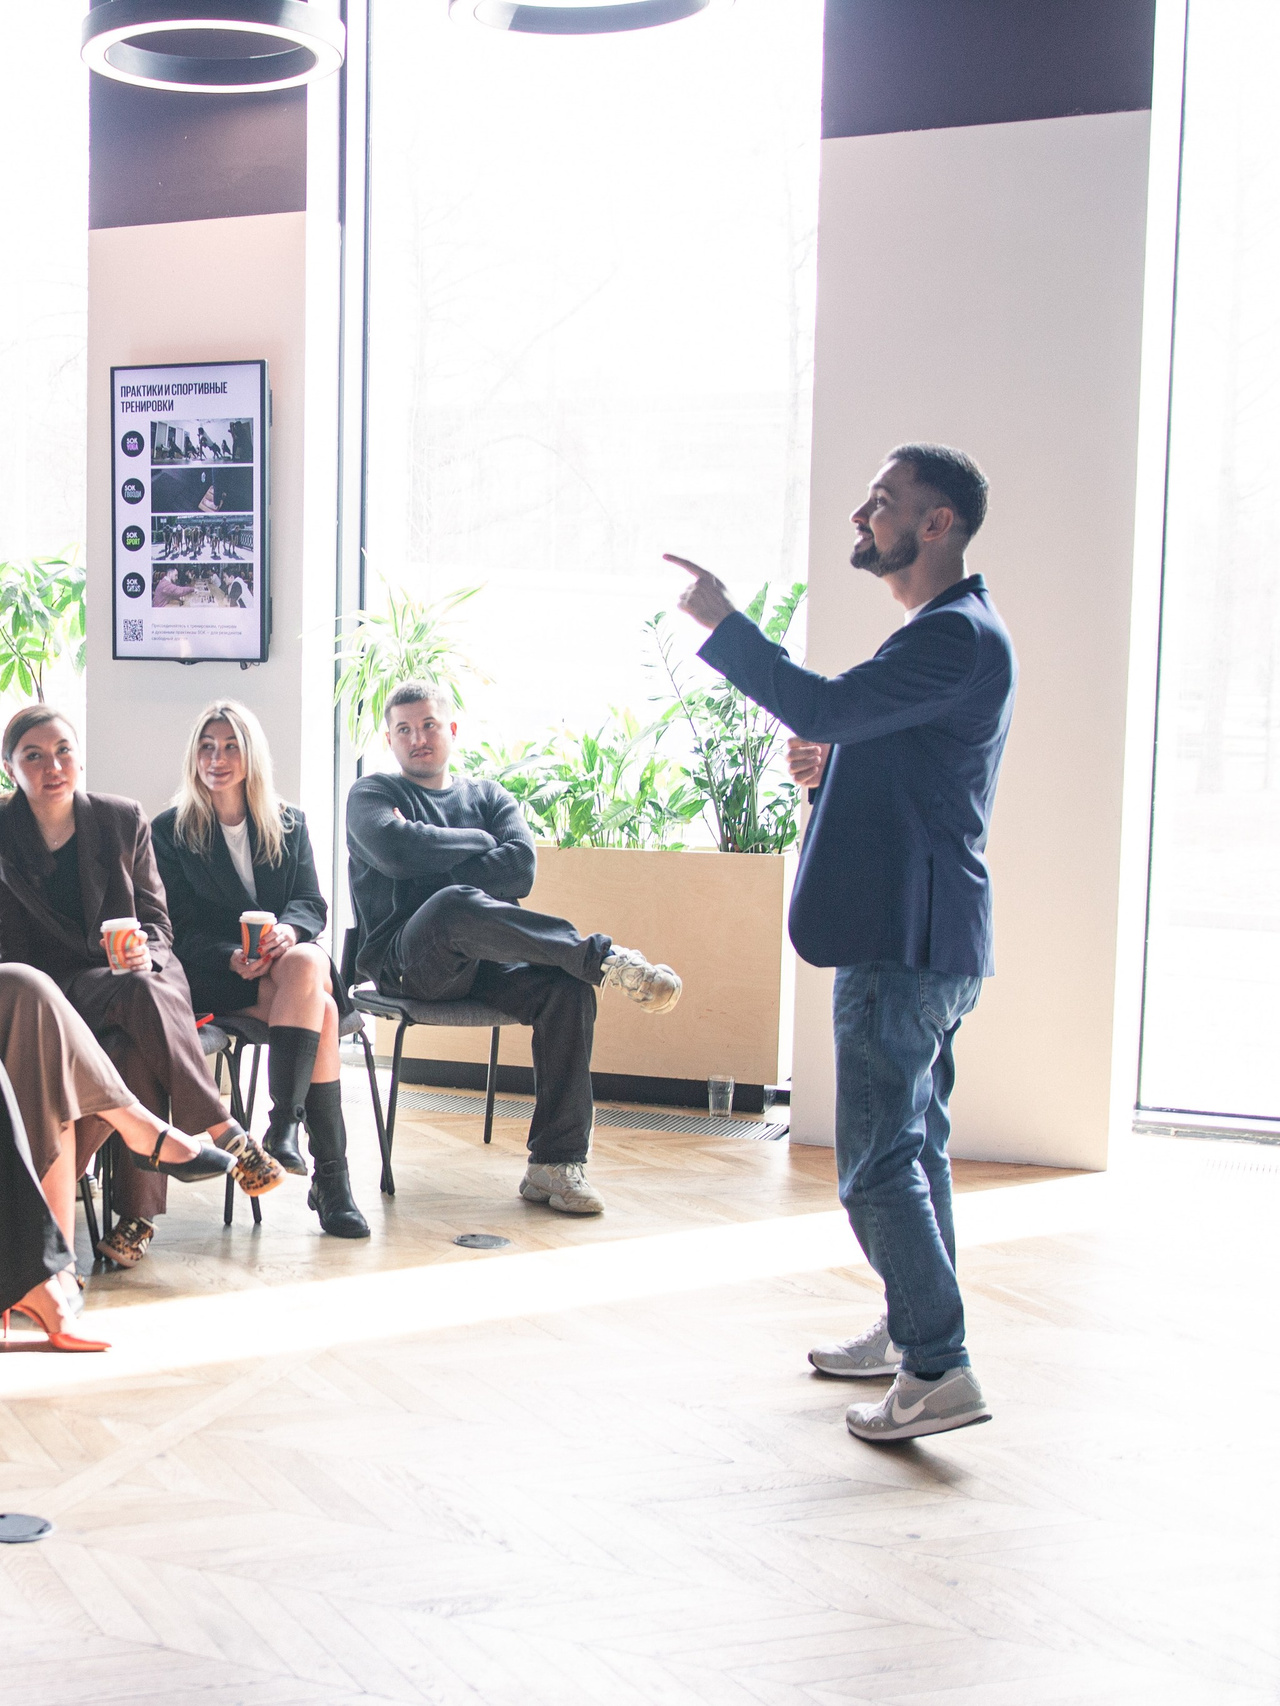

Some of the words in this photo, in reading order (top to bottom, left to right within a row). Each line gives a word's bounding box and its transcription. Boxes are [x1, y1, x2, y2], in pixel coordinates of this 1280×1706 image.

[120, 384, 163, 398] ПРАКТИКИ
[164, 384, 170, 396] И
[171, 382, 228, 396] СПОРТИВНЫЕ
[121, 399, 174, 413] ТРЕНИРОВКИ
[126, 538, 140, 546] SPORT
